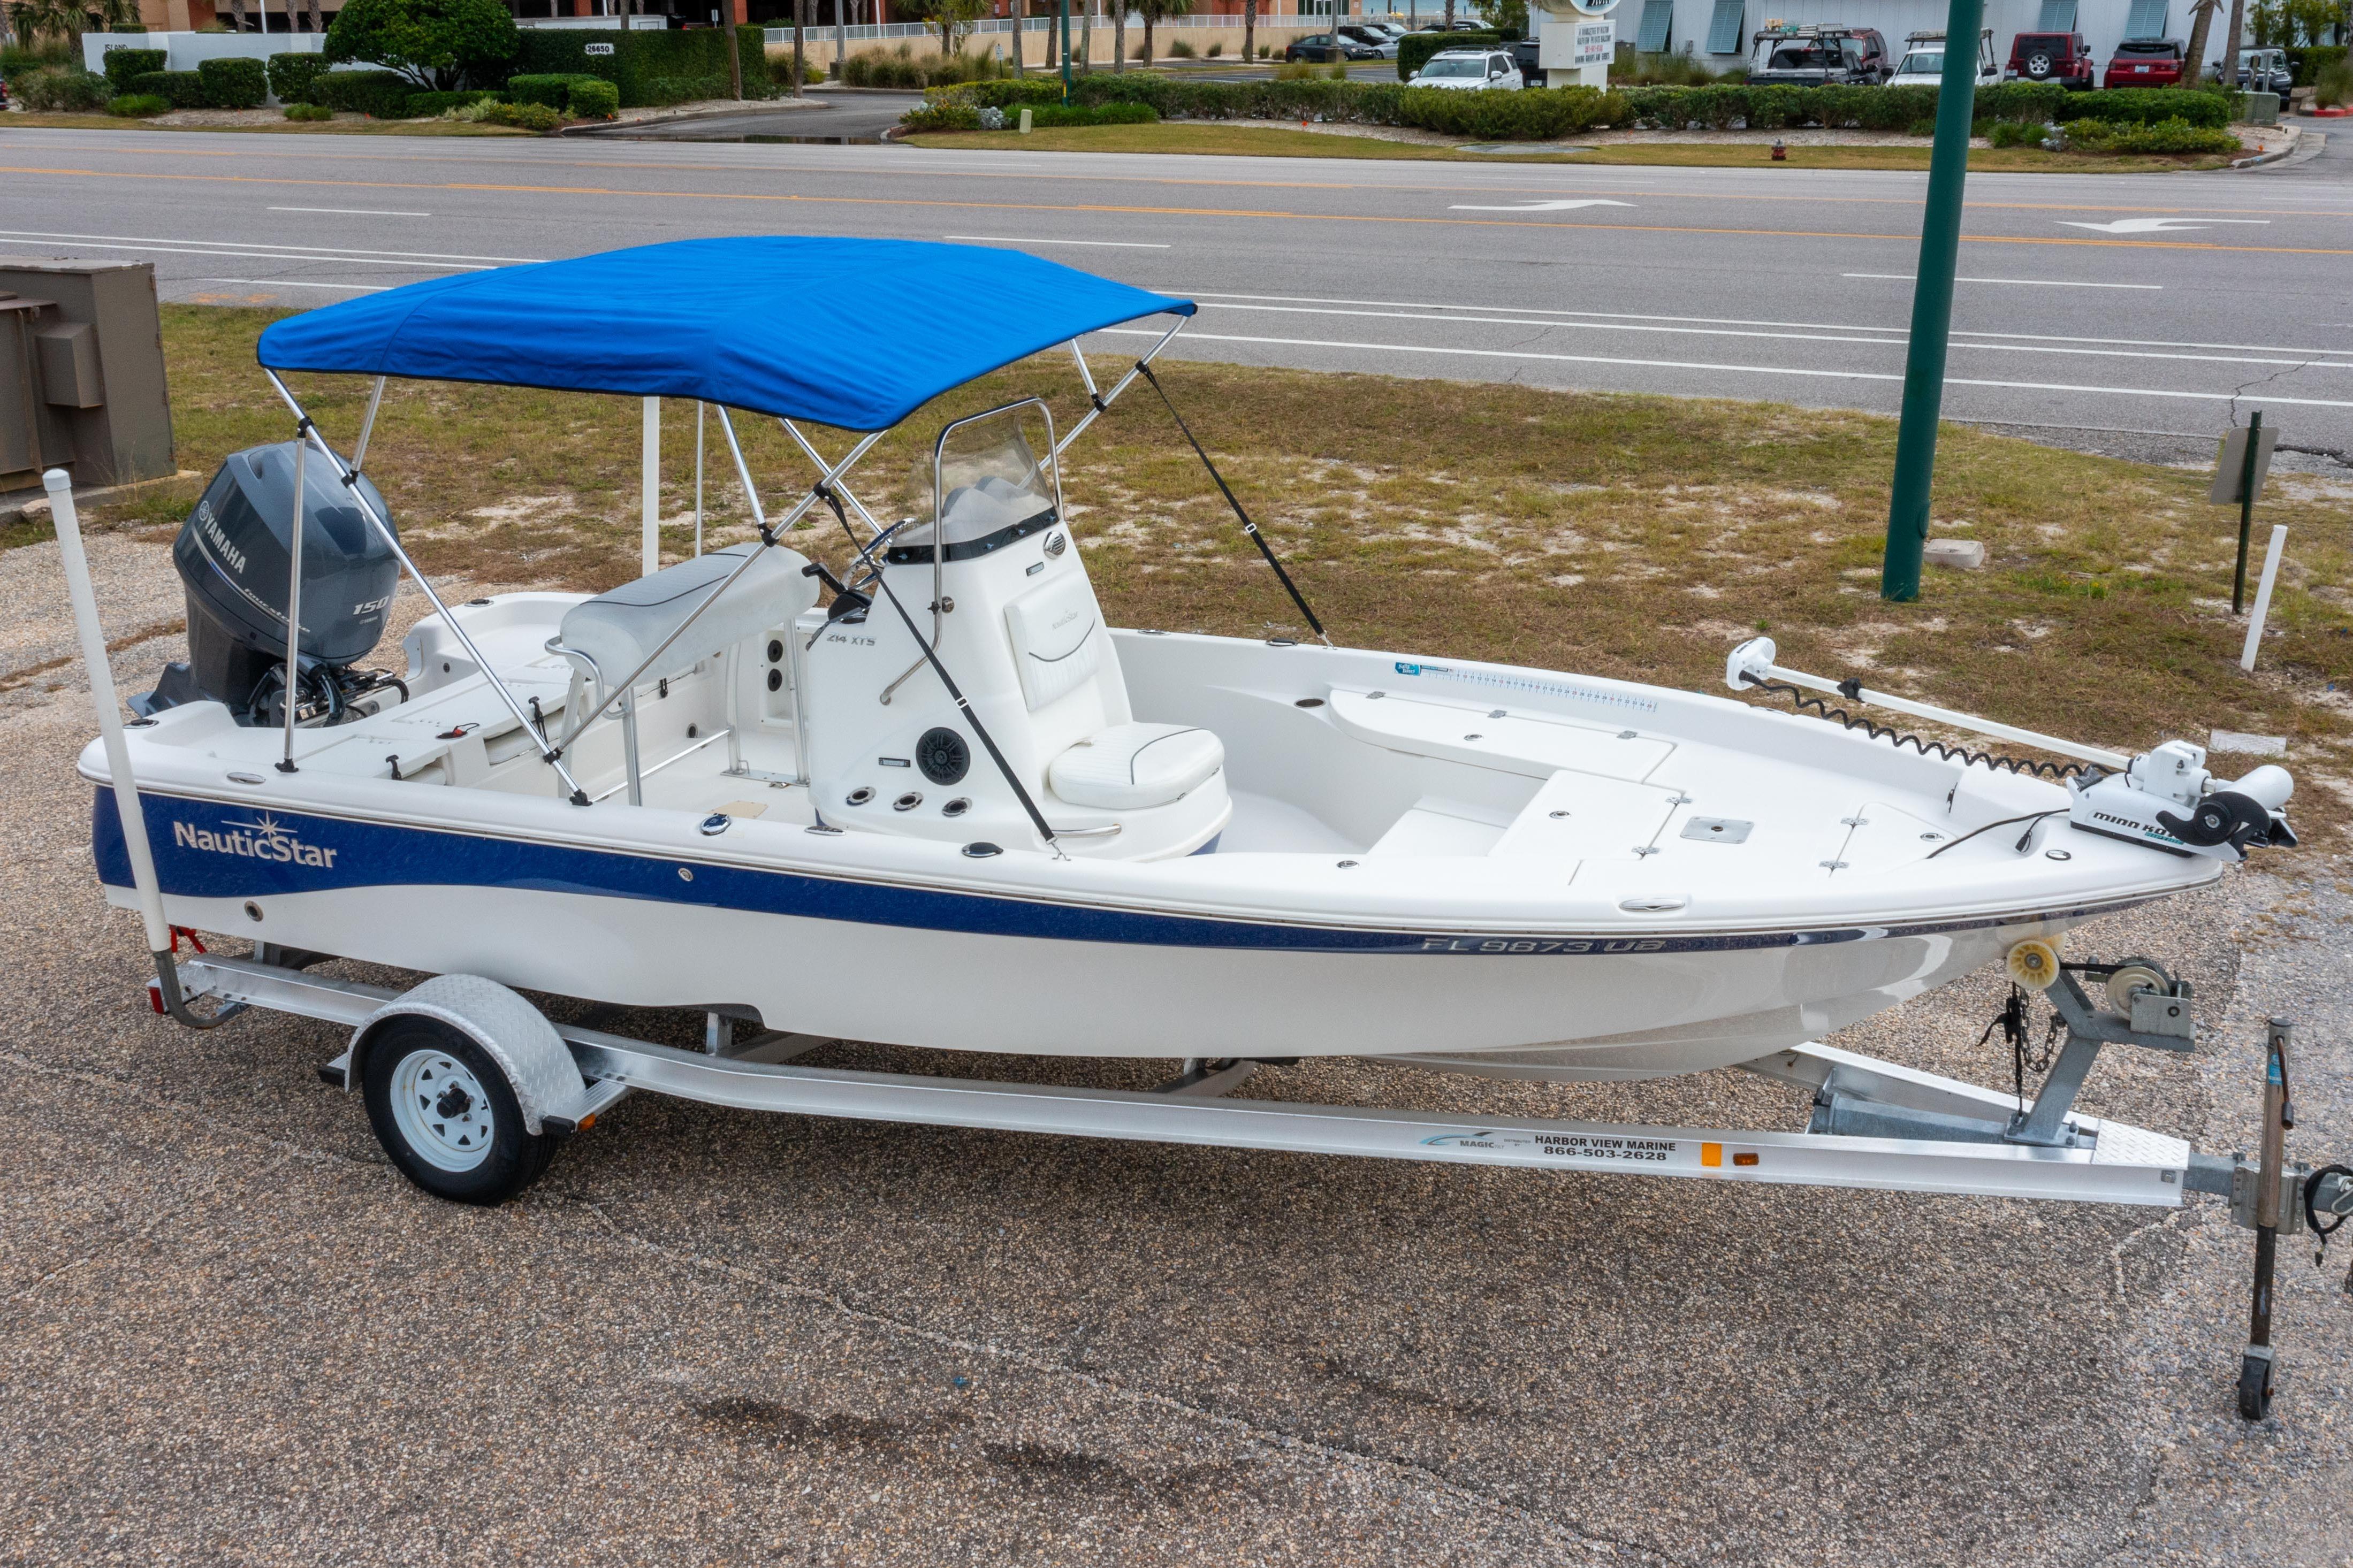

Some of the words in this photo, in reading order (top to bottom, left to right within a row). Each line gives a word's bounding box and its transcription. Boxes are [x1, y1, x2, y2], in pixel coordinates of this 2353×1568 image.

[205, 512, 246, 573] YAMAHA
[353, 595, 389, 615] 150
[173, 821, 337, 868] NauticStar
[1421, 938, 1470, 952] FL
[1479, 941, 1594, 953] 9873
[1460, 1140, 1495, 1149] MAGIC
[1535, 1136, 1587, 1147] HARBOR
[1591, 1139, 1623, 1149] VIEW
[1627, 1141, 1676, 1151] MARINE
[1544, 1146, 1667, 1160] 866-503-2628
